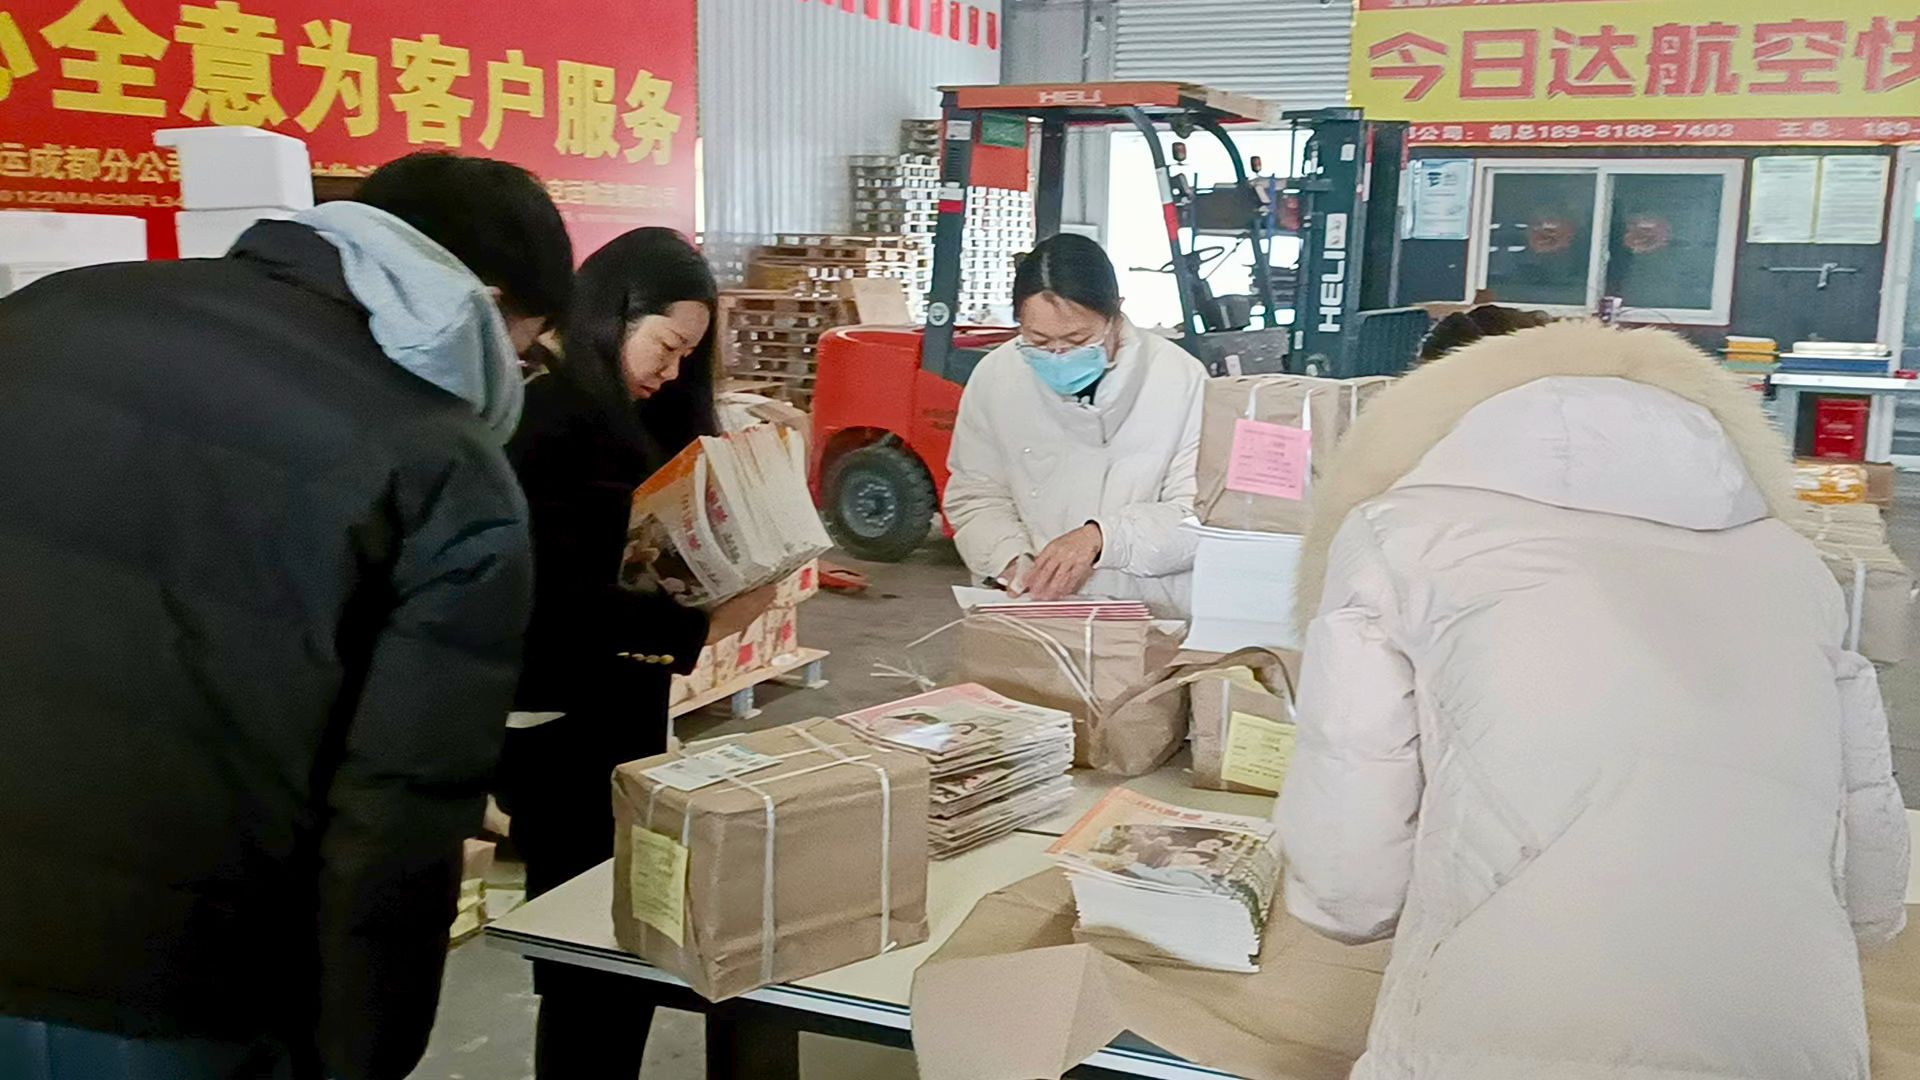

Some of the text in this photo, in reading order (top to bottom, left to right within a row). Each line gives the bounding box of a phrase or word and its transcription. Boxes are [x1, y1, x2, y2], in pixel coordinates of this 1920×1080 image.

[1369, 16, 1920, 101] 今日达航空快
[1318, 250, 1346, 333] HELI
